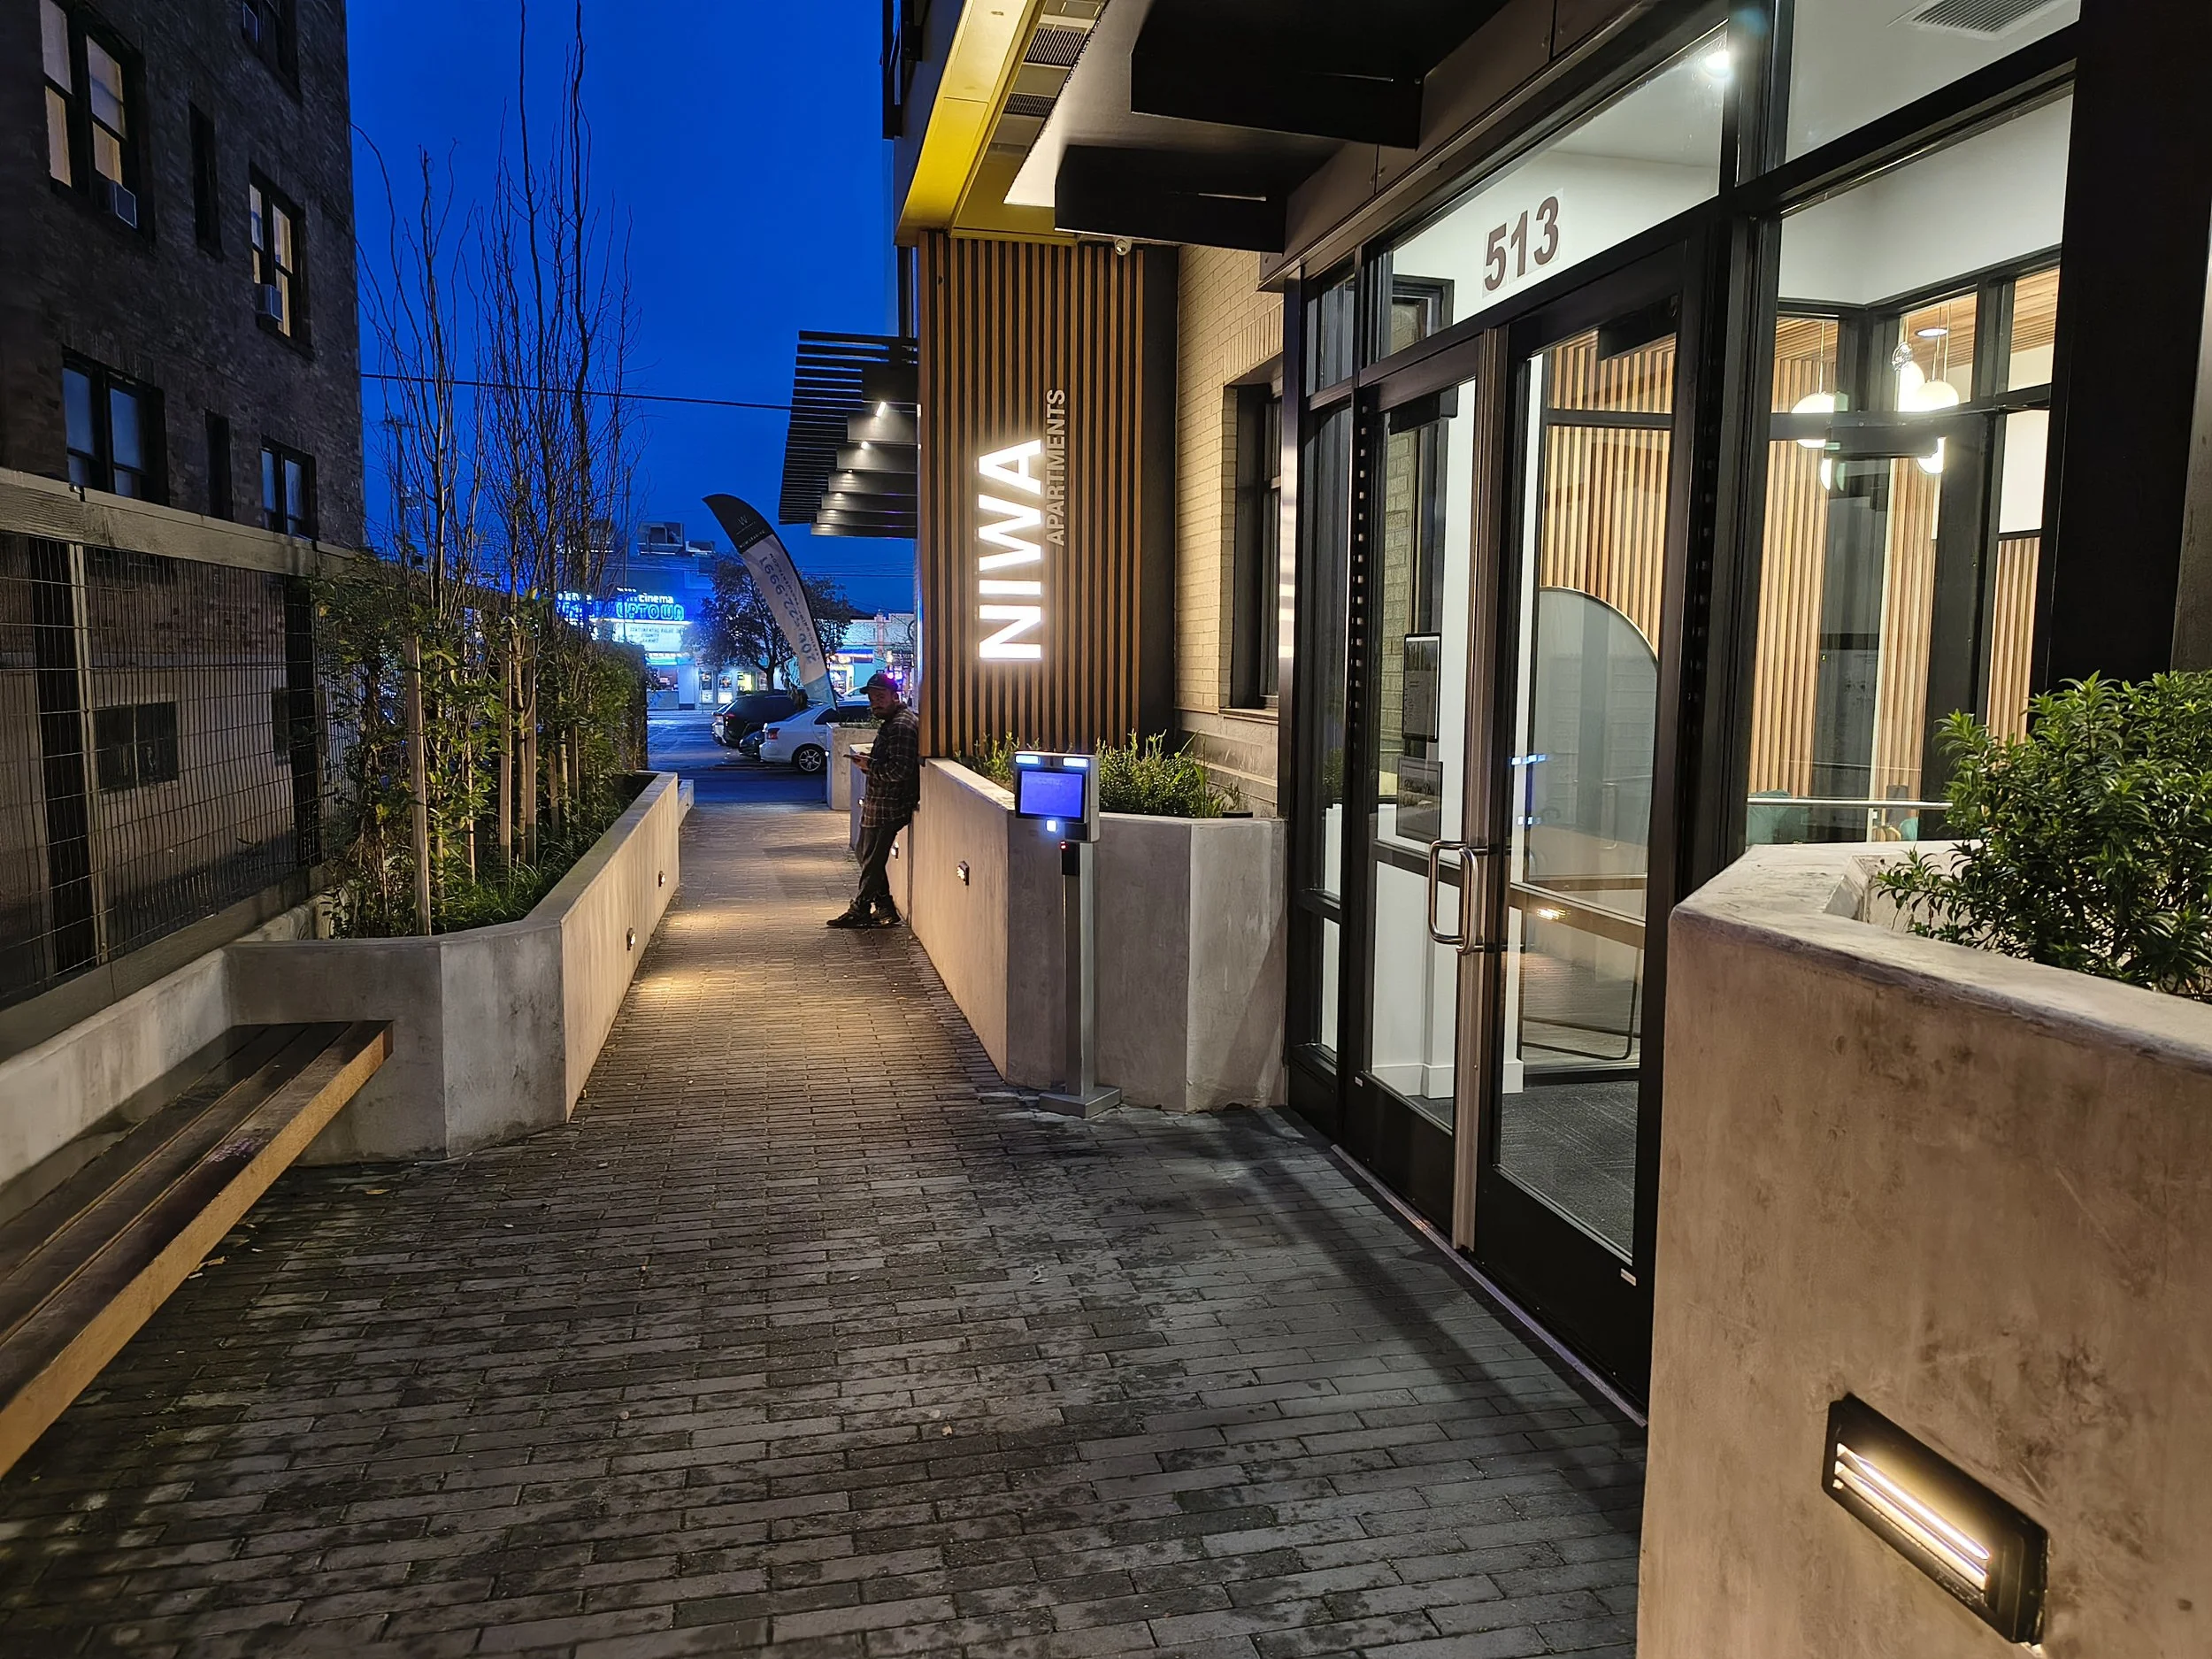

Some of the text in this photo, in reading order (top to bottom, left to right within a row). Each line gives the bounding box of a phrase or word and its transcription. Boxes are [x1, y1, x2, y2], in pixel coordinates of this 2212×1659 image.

[1485, 196, 1558, 291] 513
[1046, 389, 1066, 546] APARTMENTS
[979, 438, 1041, 659] NIWA
[616, 602, 685, 621] UPTOWN
[638, 593, 674, 604] cinema
